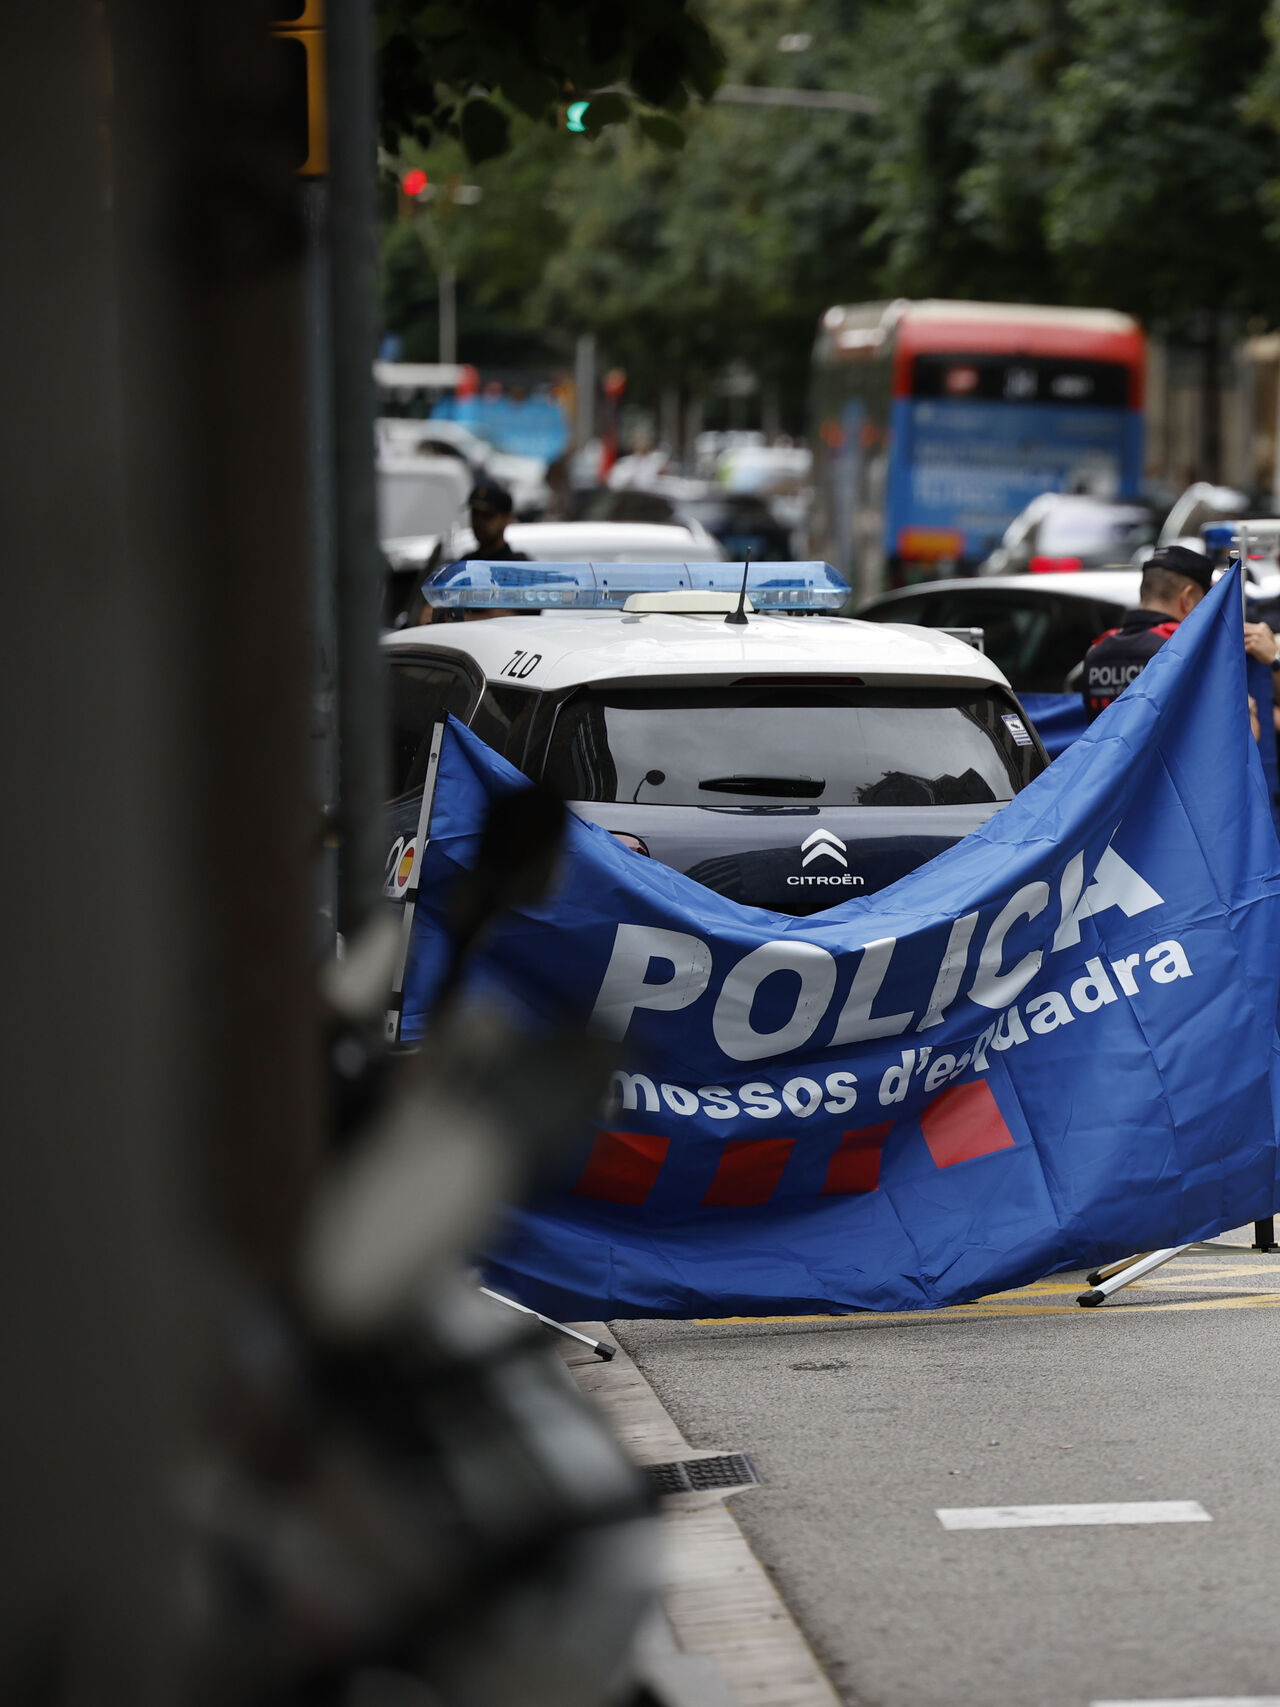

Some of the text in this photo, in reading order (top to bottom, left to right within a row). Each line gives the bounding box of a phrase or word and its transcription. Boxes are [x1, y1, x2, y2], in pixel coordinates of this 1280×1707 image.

[500, 649, 542, 679] 7LD
[1088, 665, 1144, 685] POLIC
[786, 873, 865, 886] CITROËN
[605, 1070, 858, 1121] mossos
